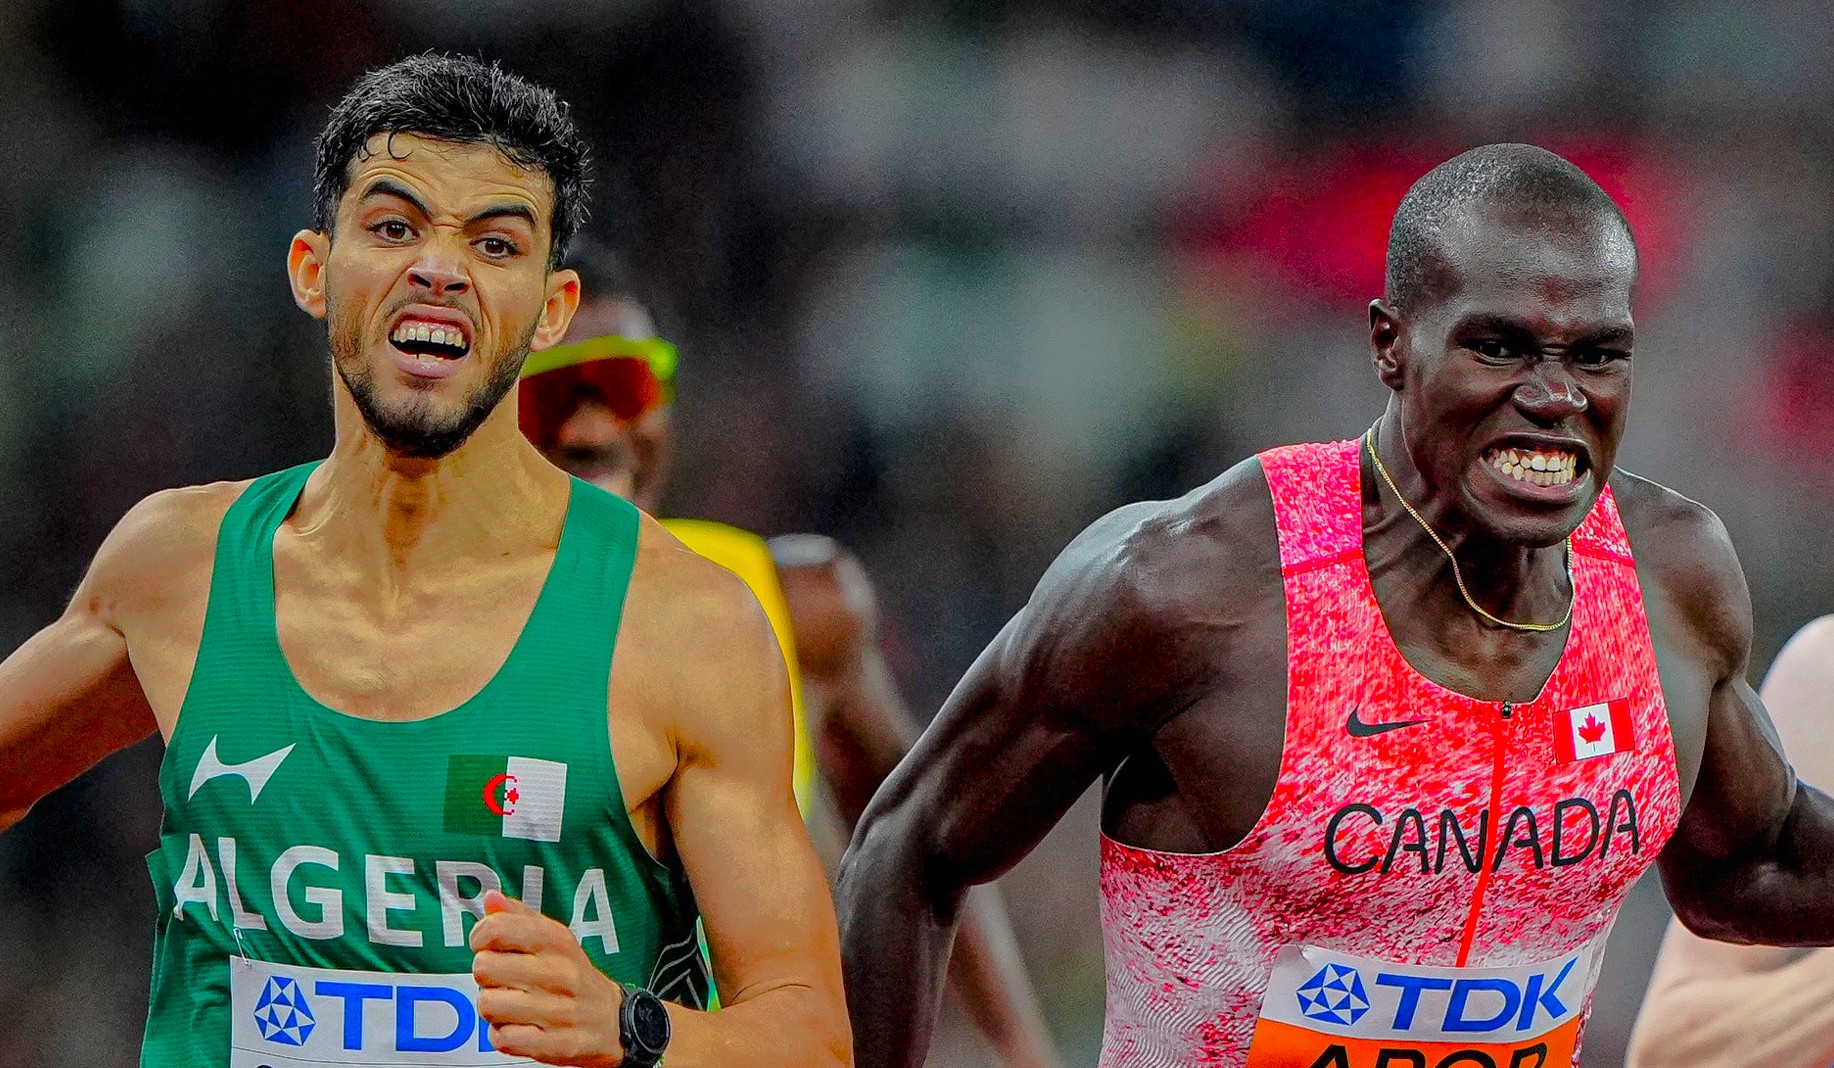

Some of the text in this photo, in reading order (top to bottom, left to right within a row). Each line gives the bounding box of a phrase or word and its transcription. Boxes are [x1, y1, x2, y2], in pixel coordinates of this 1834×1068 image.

[1324, 789, 1640, 875] CANADA
[174, 832, 620, 956] ALGERIA
[1375, 956, 1578, 1032] TDK
